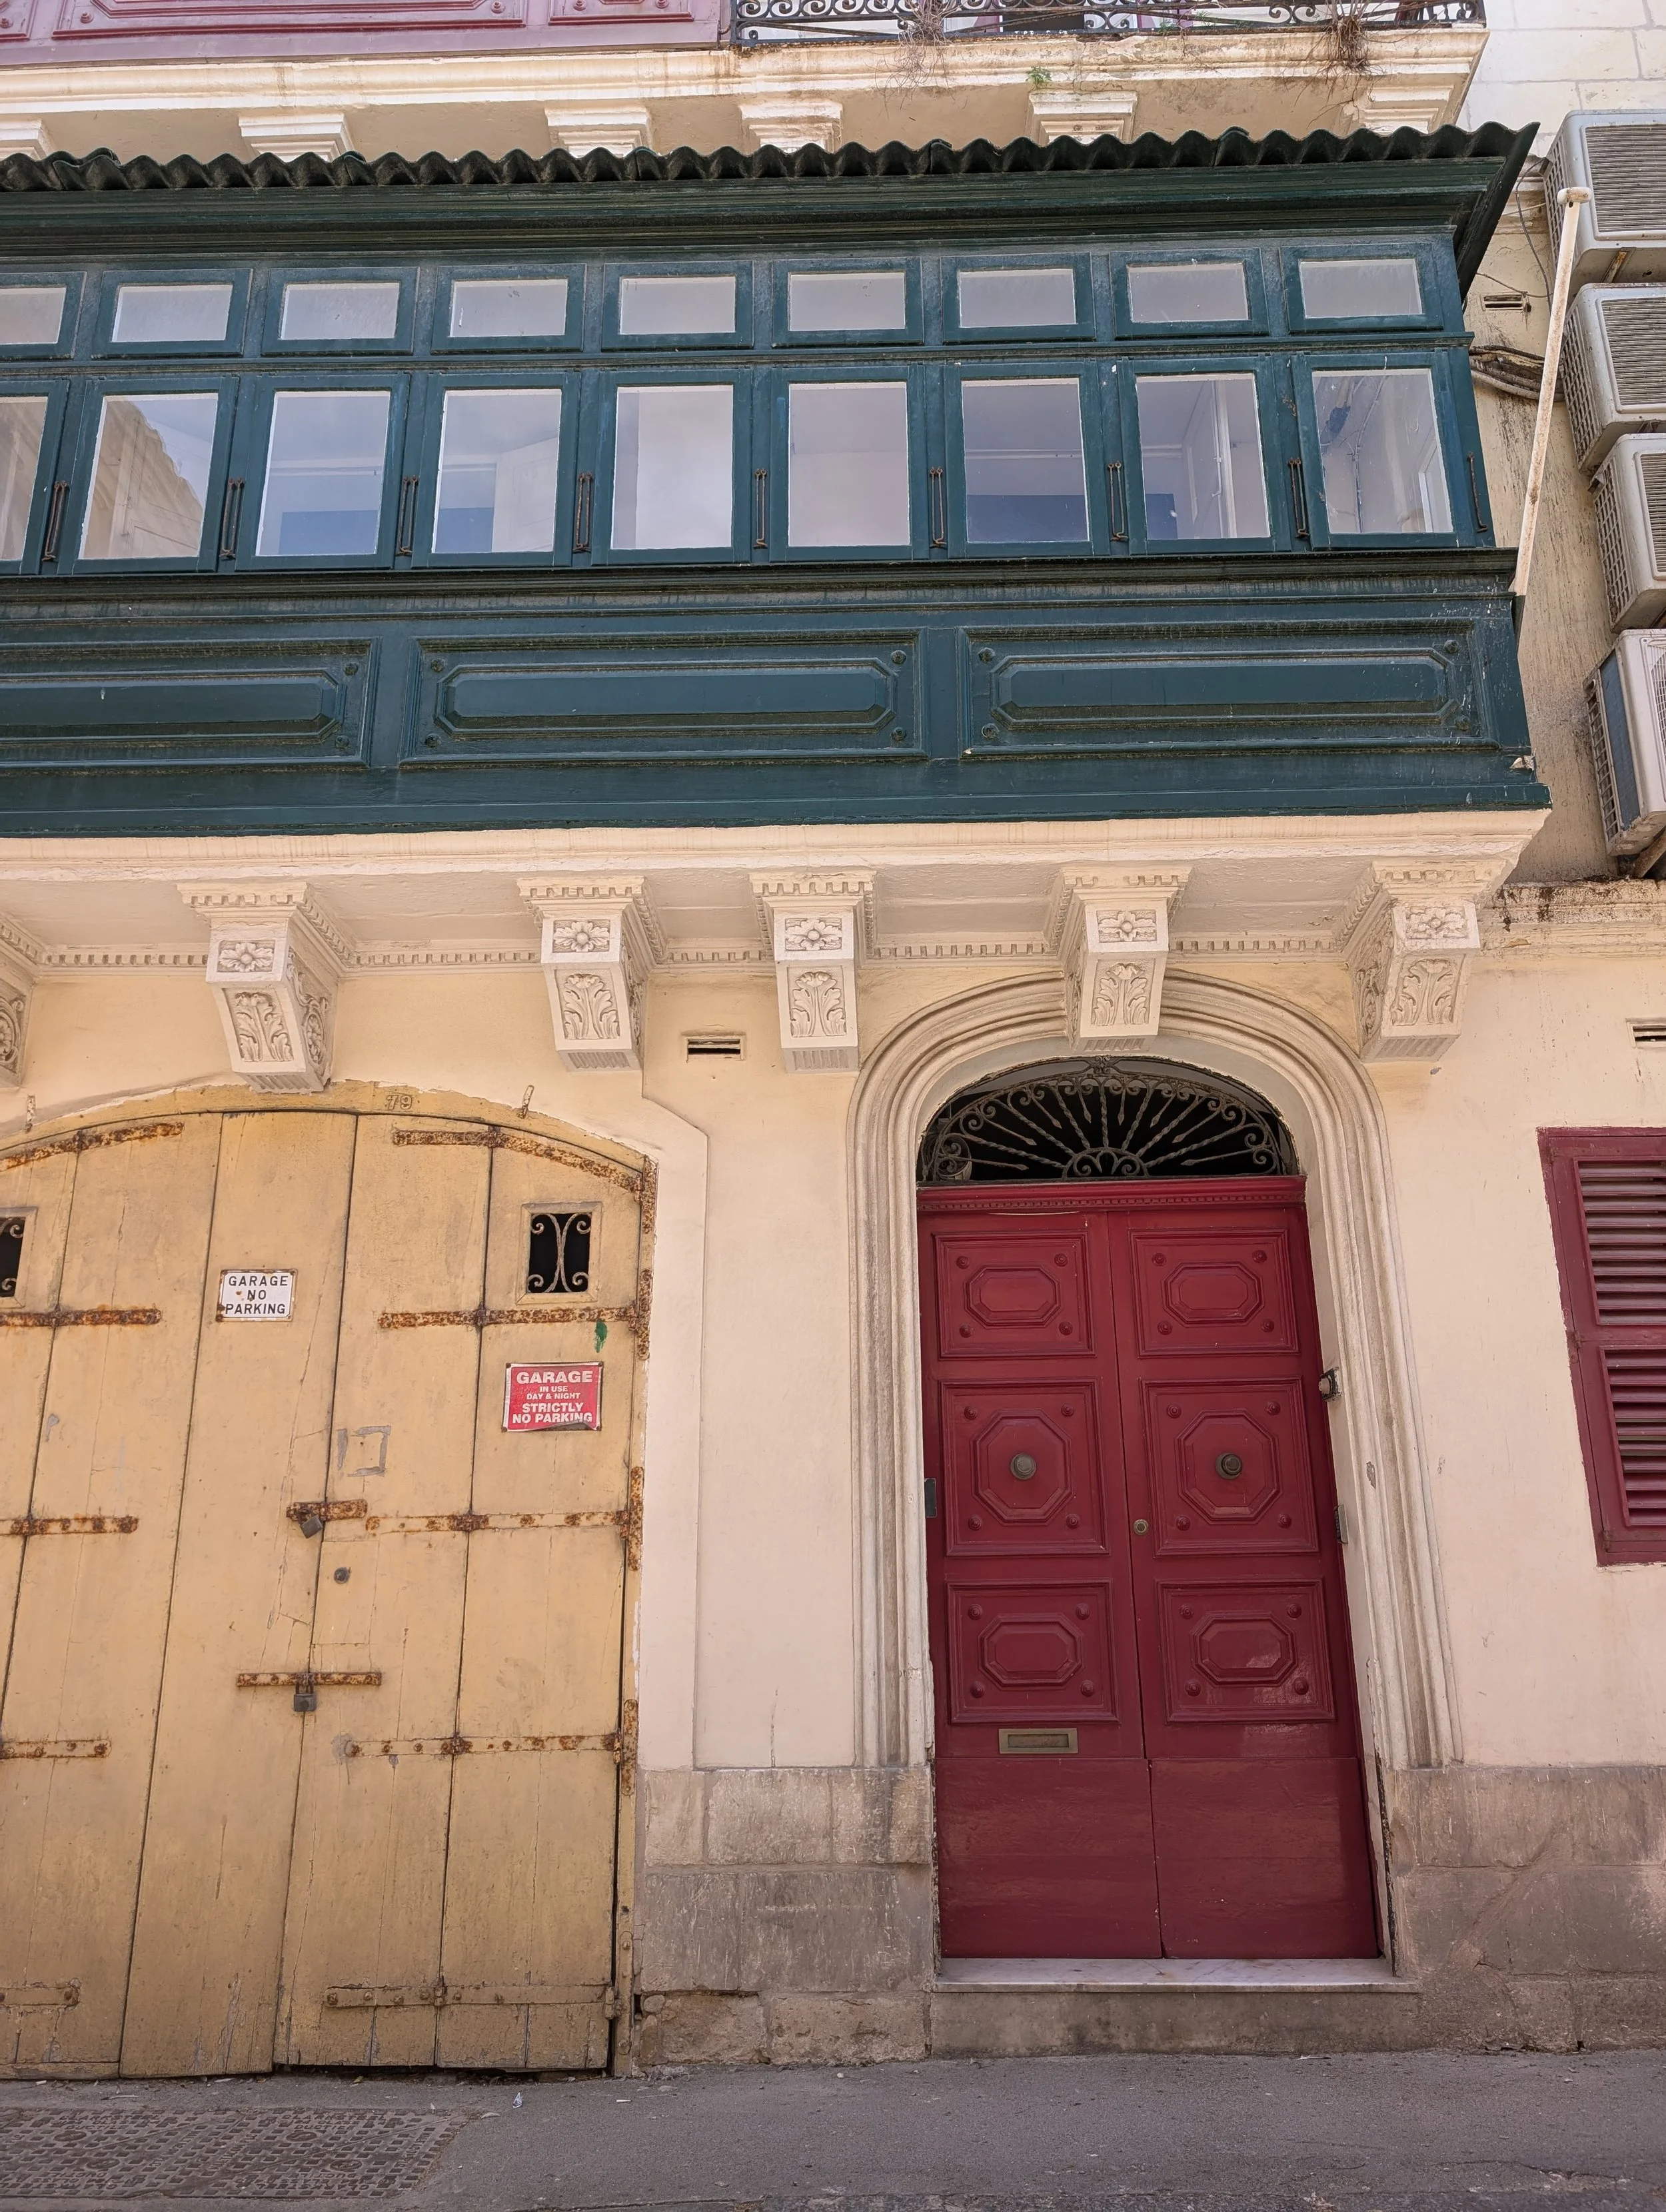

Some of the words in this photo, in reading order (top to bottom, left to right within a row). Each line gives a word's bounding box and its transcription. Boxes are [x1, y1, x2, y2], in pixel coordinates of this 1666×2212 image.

[387, 1095, 412, 1110] 79
[229, 1276, 288, 1286] GARAGE
[247, 1290, 267, 1300] NO
[225, 1304, 285, 1314] PARKING
[516, 1371, 593, 1384] GARAGE
[522, 1402, 584, 1412] STRICTLY
[512, 1414, 531, 1423] NO
[534, 1412, 592, 1423] PARKING
